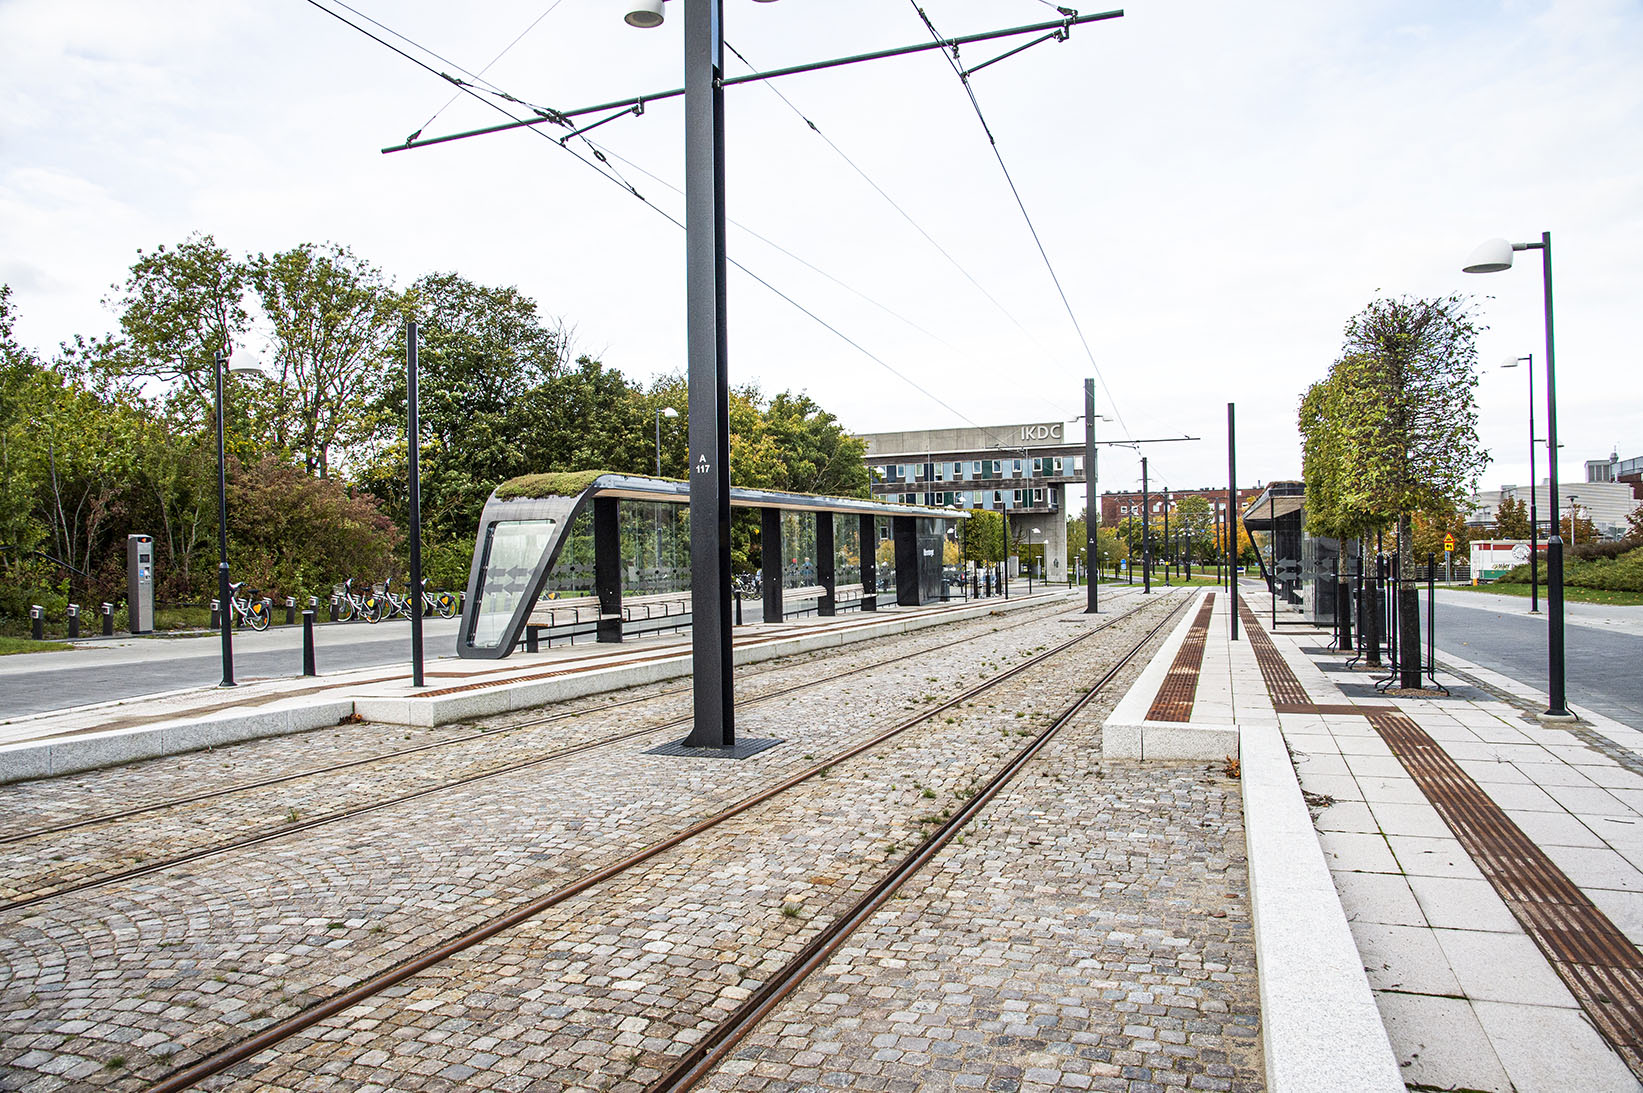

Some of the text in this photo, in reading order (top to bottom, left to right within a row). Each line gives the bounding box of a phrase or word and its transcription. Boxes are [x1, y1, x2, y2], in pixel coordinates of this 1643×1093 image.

[1021, 424, 1061, 440] IKDC
[699, 454, 706, 462] A
[696, 464, 710, 473] 117
